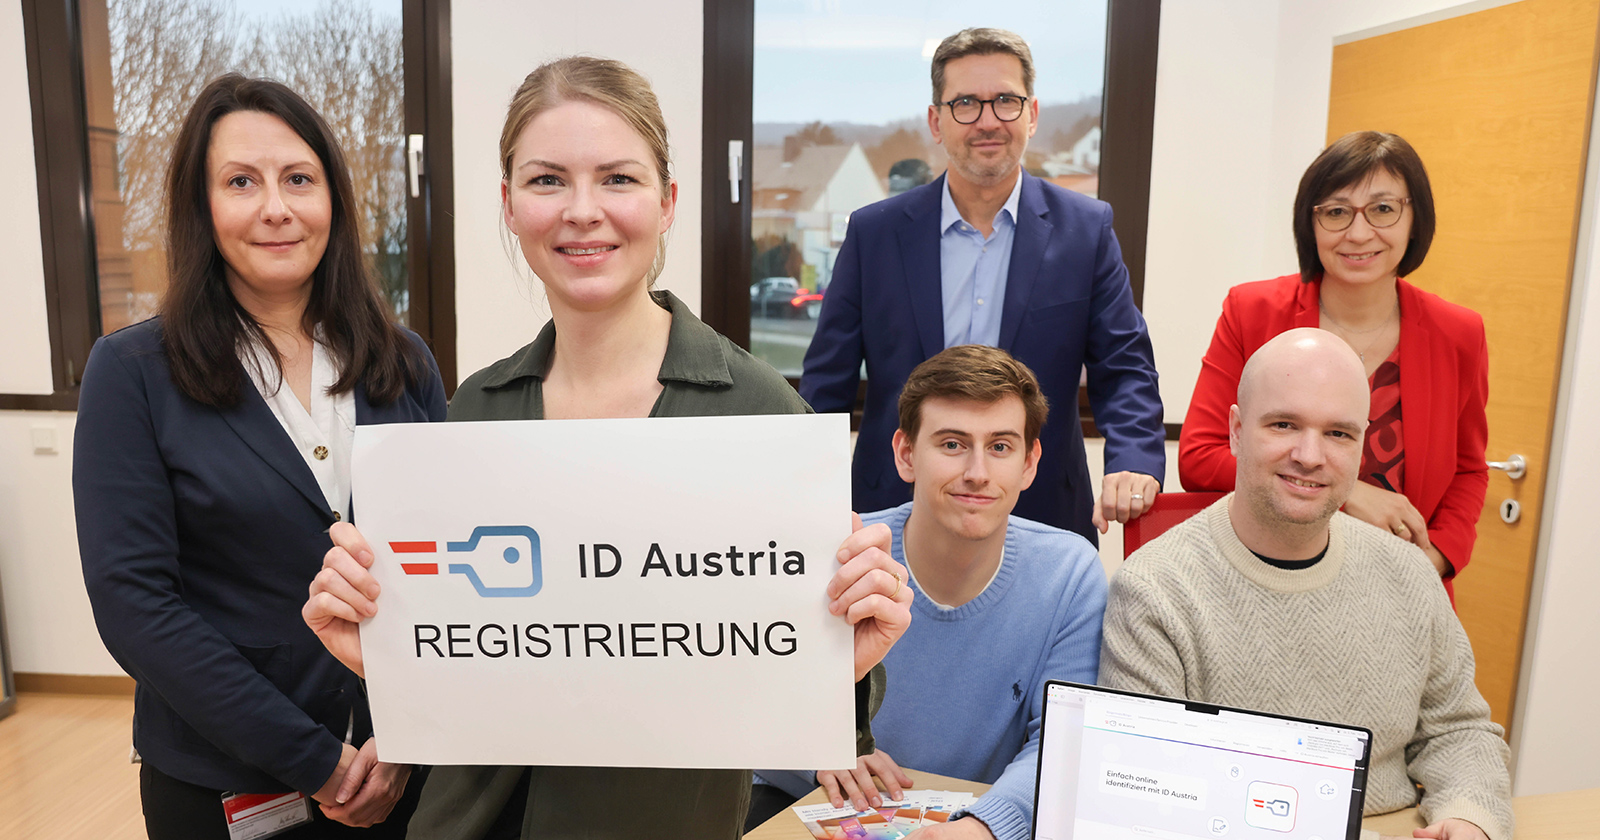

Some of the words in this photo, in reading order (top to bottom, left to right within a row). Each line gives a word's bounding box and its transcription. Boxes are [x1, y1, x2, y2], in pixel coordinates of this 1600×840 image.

[578, 543, 622, 578] ID
[640, 540, 806, 577] Austria
[413, 620, 798, 658] REGISTRIERUNG
[1105, 778, 1146, 792] identifiziert
[1147, 786, 1160, 795] mit
[1161, 788, 1170, 796] ID
[1170, 790, 1198, 801] Austria
[1106, 769, 1134, 781] Einfach
[1135, 776, 1158, 785] online
